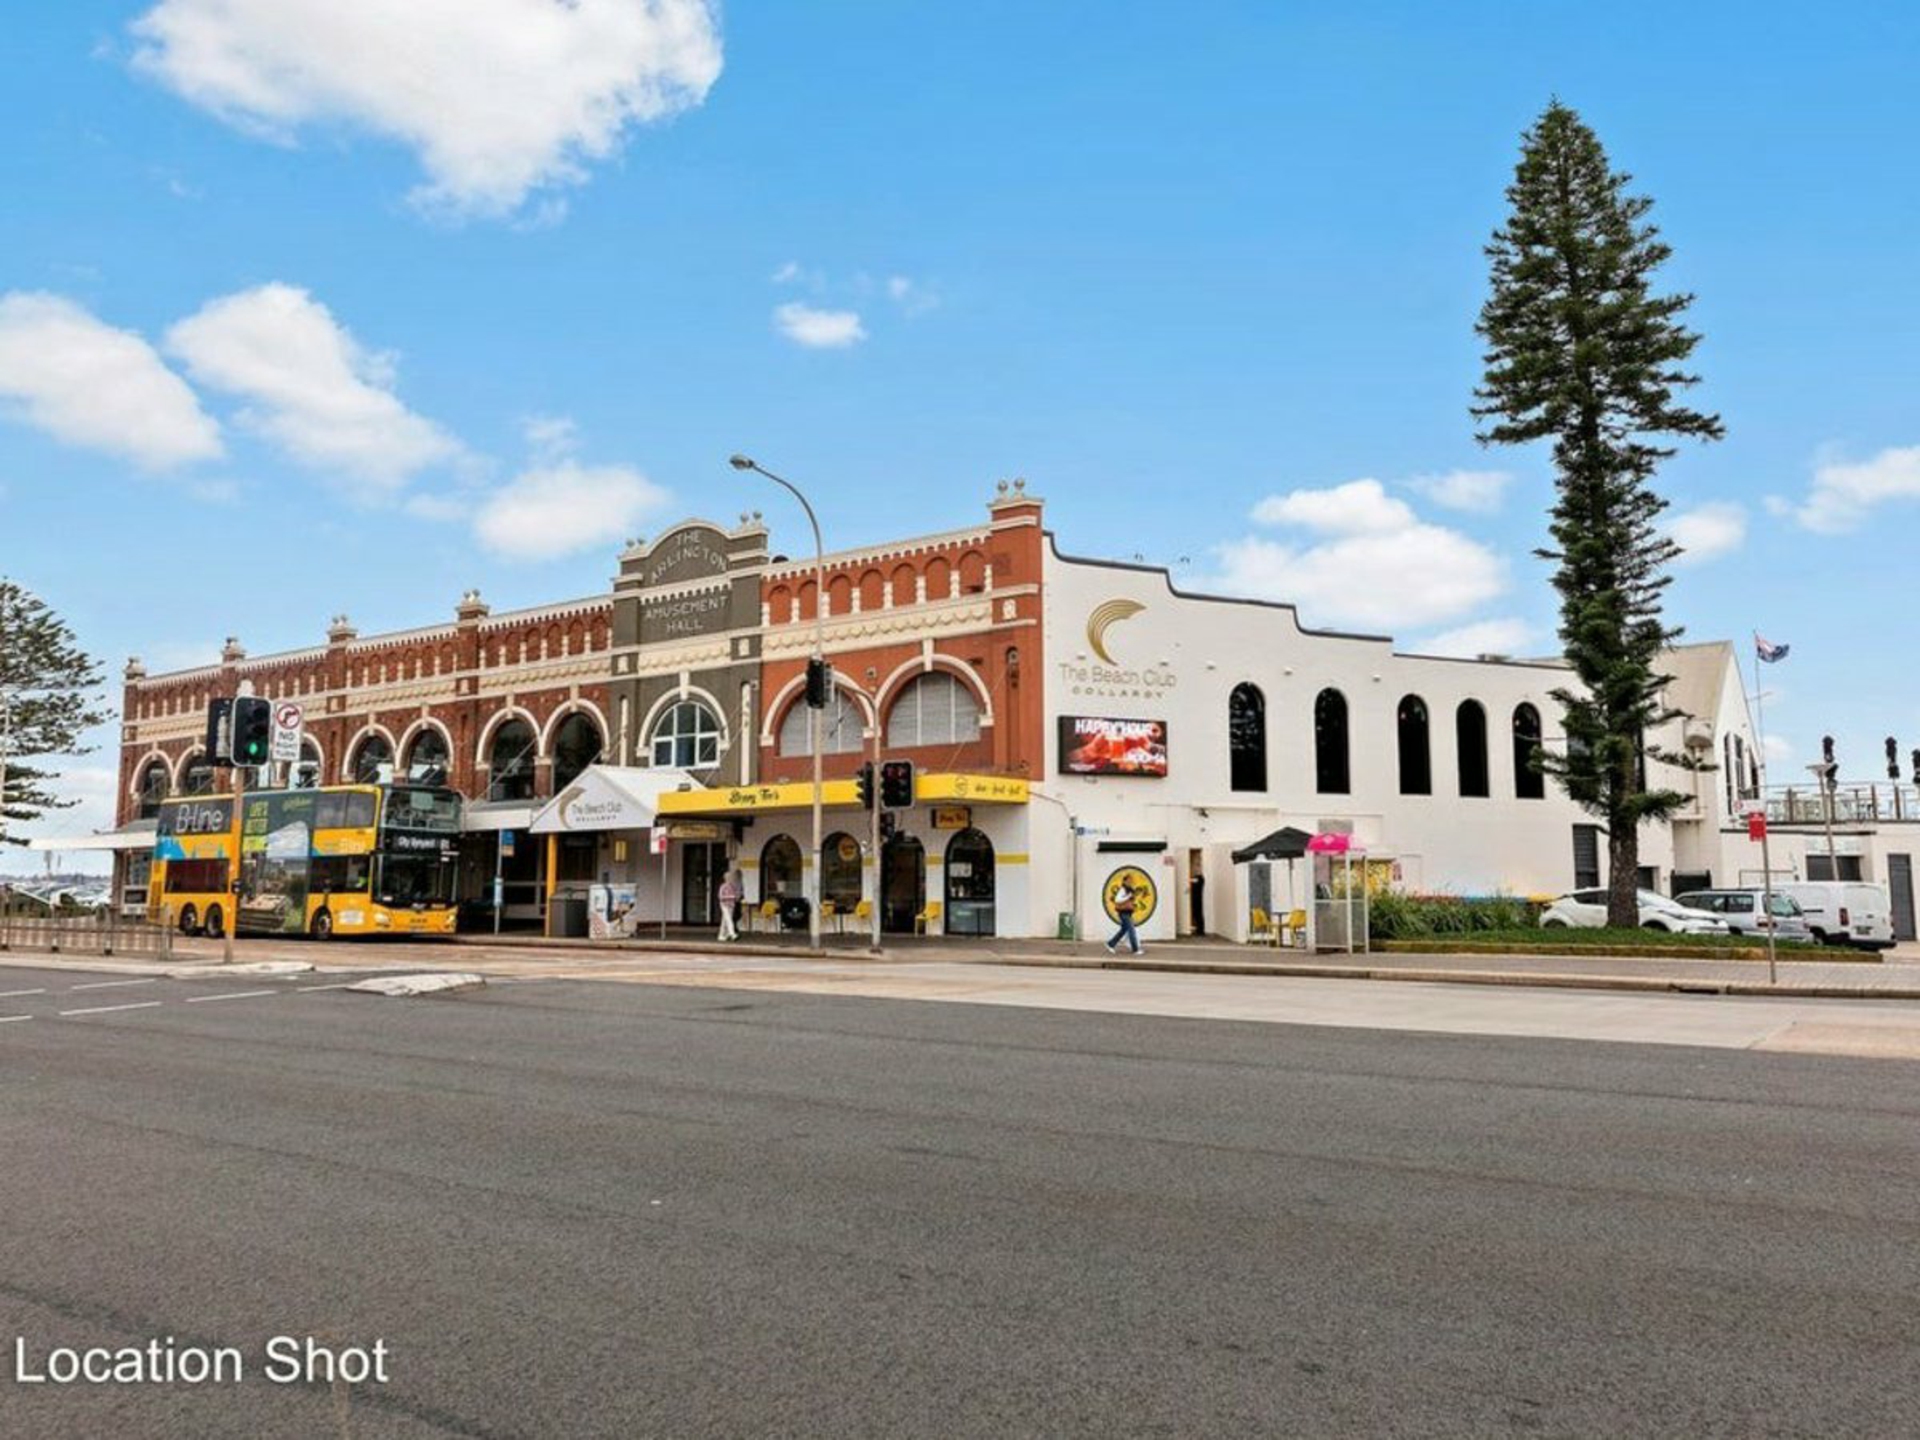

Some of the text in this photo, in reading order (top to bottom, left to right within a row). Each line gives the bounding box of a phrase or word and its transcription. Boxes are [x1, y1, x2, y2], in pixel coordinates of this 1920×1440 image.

[676, 530, 701, 545] THE
[651, 546, 727, 584] ARLINGTON
[645, 596, 728, 620] AMUSEMENT
[666, 620, 704, 634] HALL
[1058, 663, 1177, 687] The Beach Club
[1072, 686, 1165, 699] COLLAROY
[278, 731, 295, 742] NO
[276, 750, 297, 758] TURN
[571, 801, 623, 815] The Beach Club
[175, 803, 224, 834] B-Line
